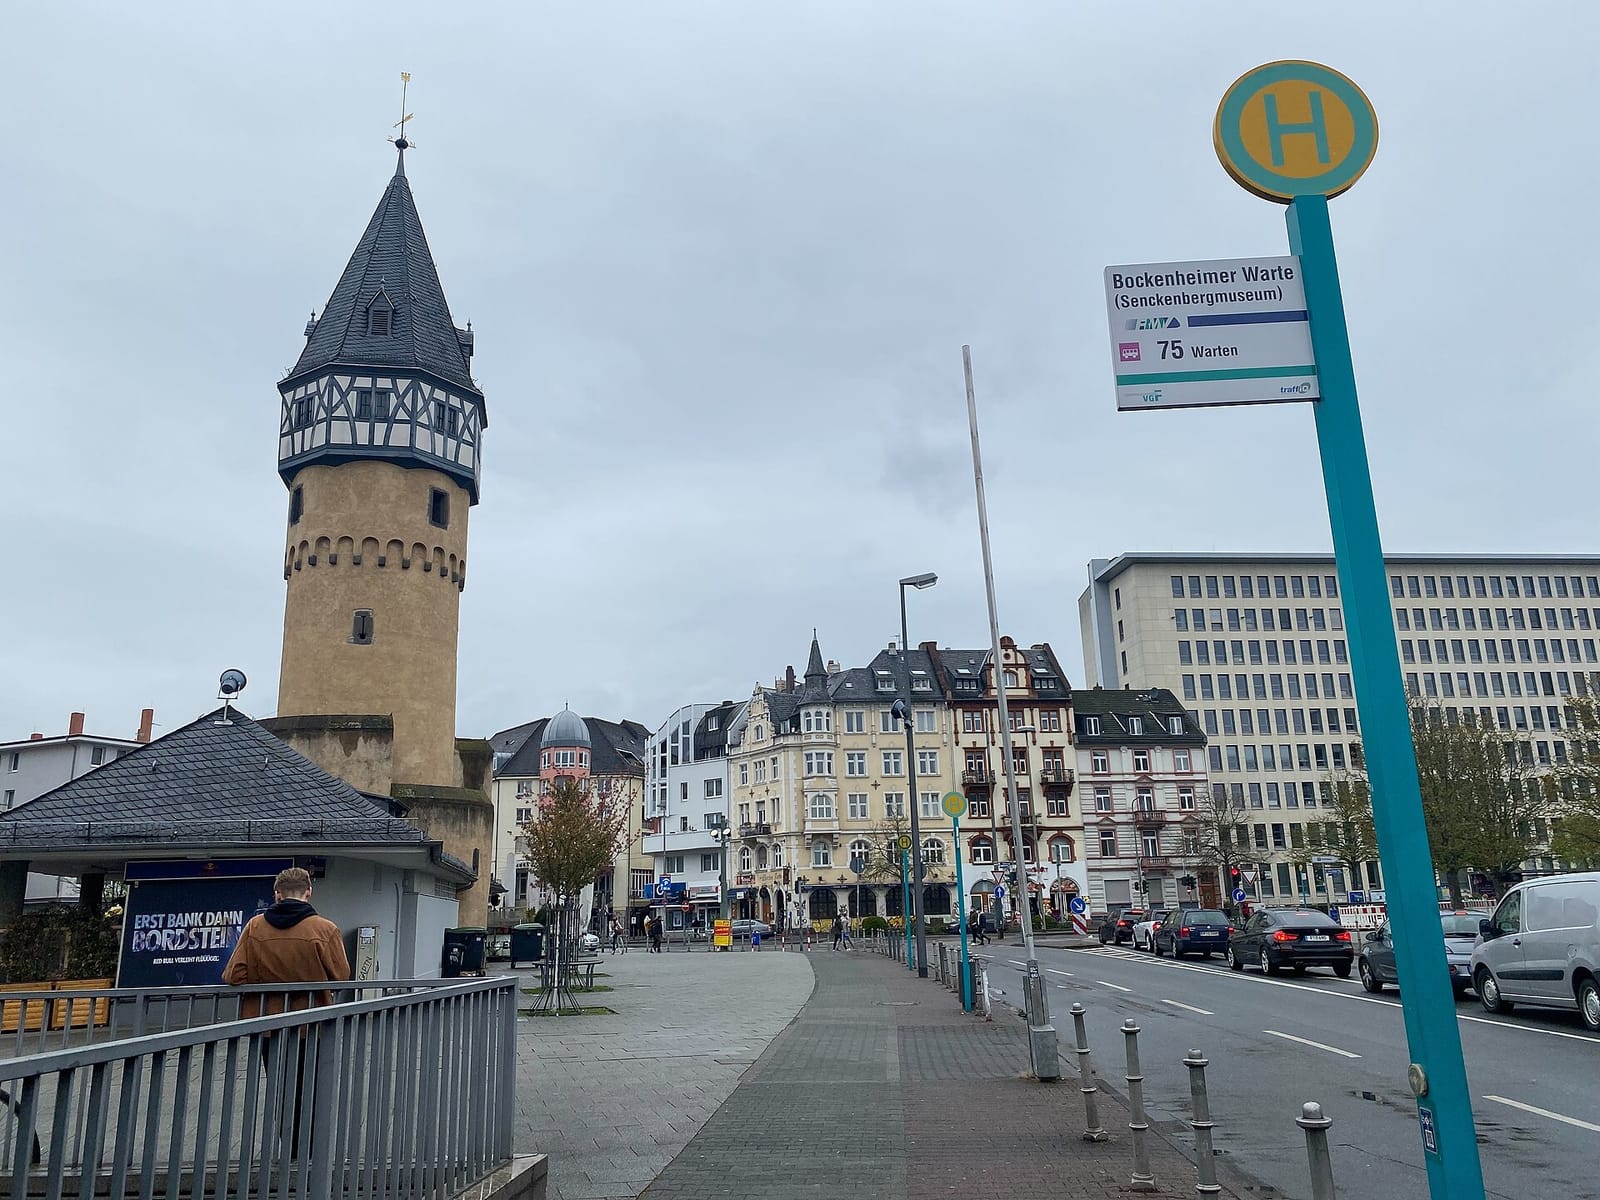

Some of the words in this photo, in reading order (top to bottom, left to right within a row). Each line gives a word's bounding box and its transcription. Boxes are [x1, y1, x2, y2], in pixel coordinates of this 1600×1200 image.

[1264, 91, 1331, 167] H
[1112, 269, 1237, 289] Bockenheimer
[1242, 265, 1294, 282] Warte
[1114, 285, 1283, 310] (Senckenbergmuseum)
[1157, 340, 1184, 360] 75
[1191, 345, 1238, 358] Warten
[134, 914, 166, 929] ERST
[167, 912, 204, 928] BANK
[205, 910, 243, 926] DANN
